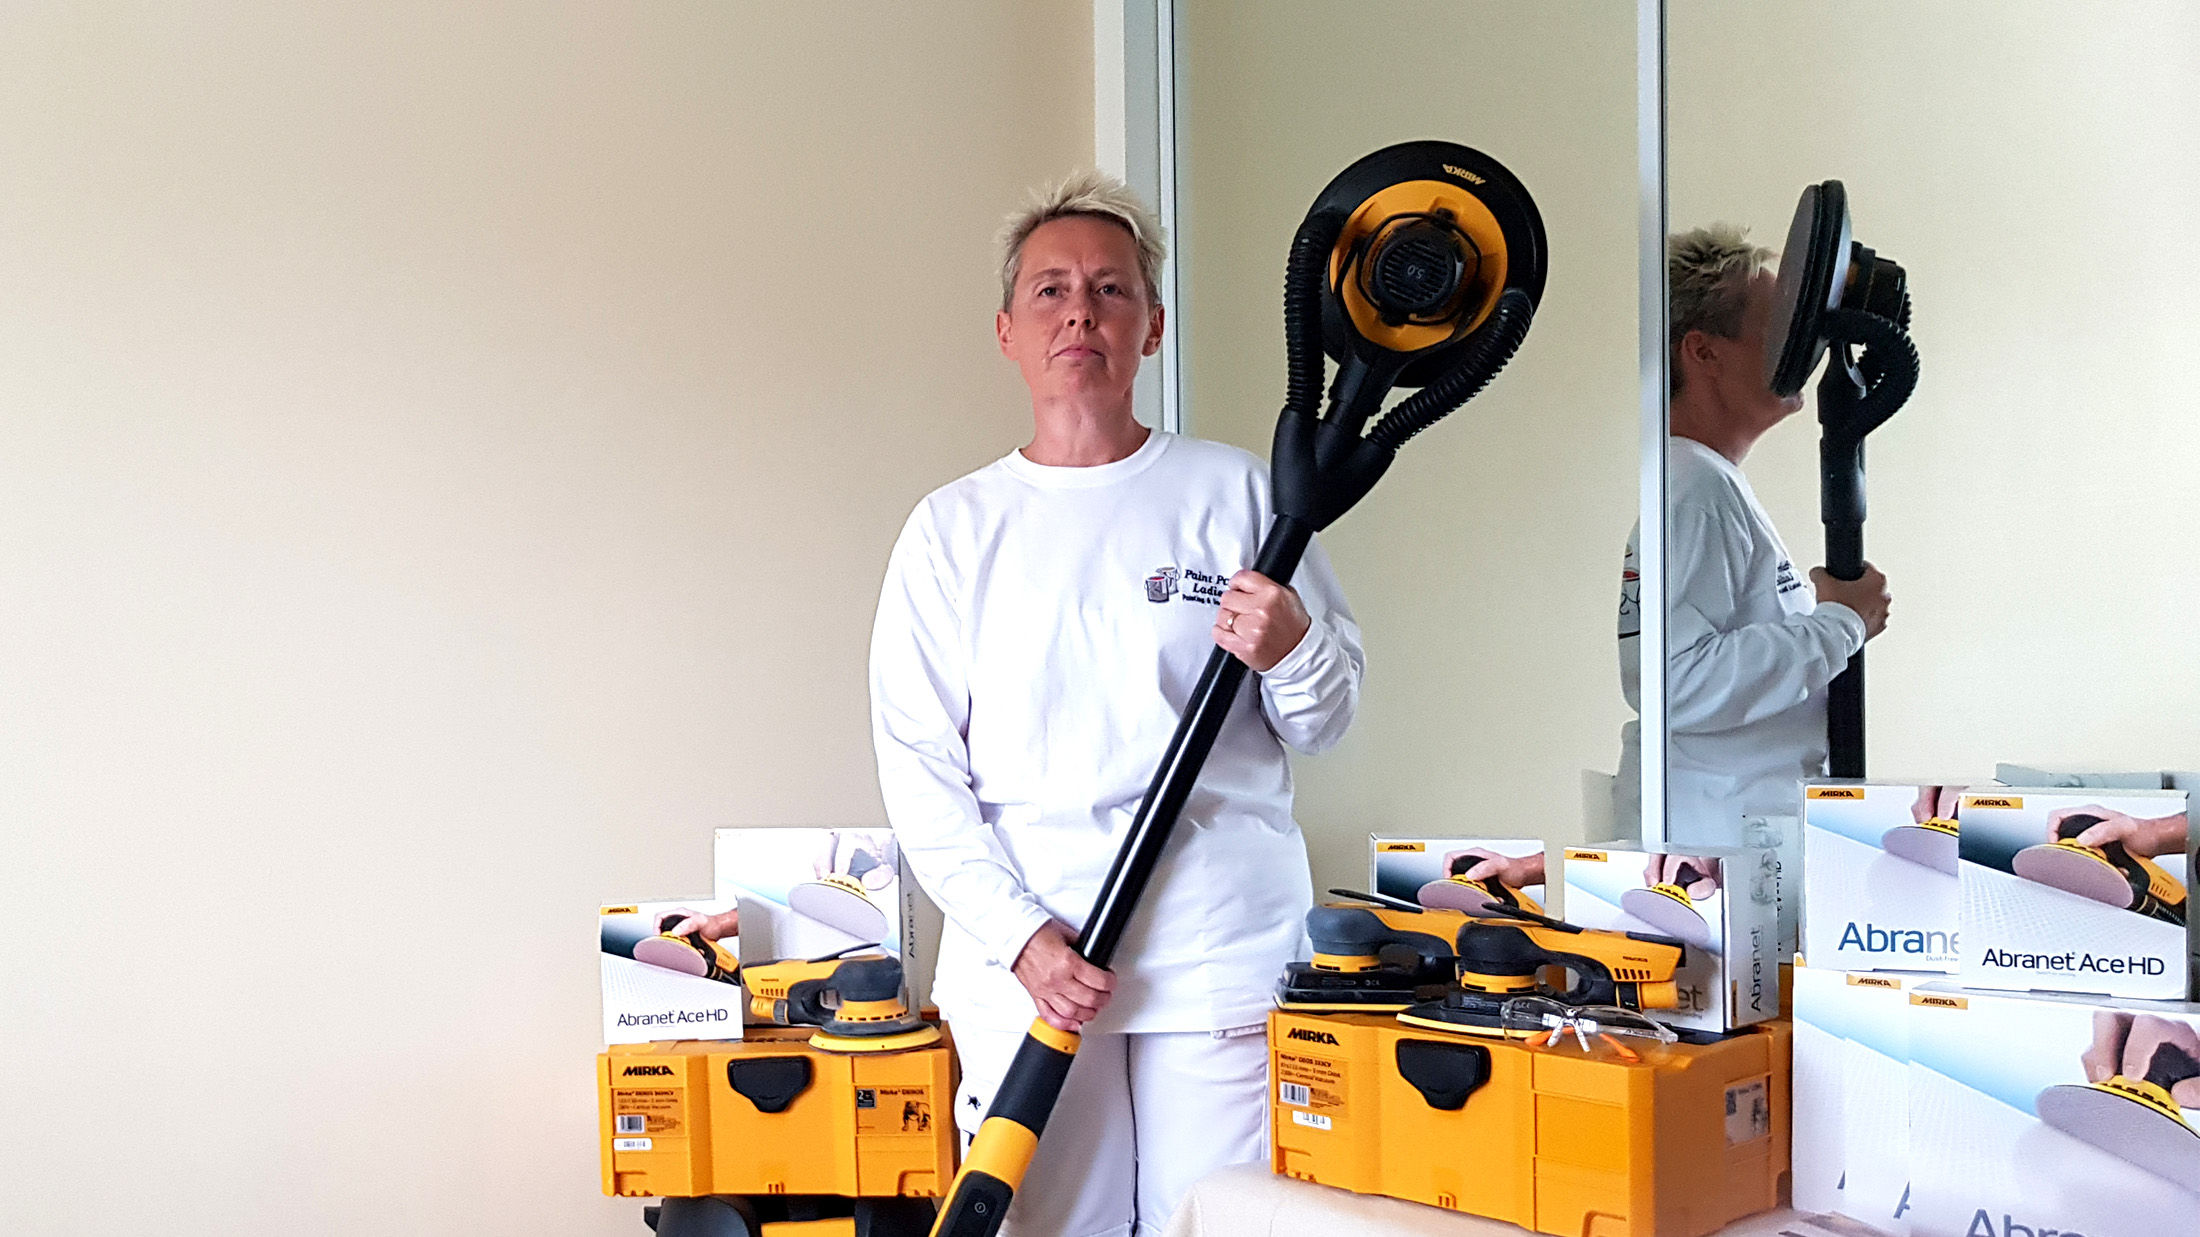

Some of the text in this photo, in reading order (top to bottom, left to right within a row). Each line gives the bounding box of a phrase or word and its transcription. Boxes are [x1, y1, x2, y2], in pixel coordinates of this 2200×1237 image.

[1443, 163, 1486, 185] MIRKA
[1185, 569, 1212, 583] Paint
[1192, 583, 1223, 597] Ladie
[1819, 790, 1854, 798] MIRKA
[1973, 799, 2011, 807] MIRKA
[1573, 852, 1600, 860] MIRKA
[1838, 922, 1959, 954] Abrane
[1750, 926, 1761, 1012] Abranet
[2078, 953, 2125, 973] Ace
[2128, 956, 2165, 976] HD
[1857, 978, 1892, 987] MIRKA
[1921, 997, 1957, 1007] MIRKA
[677, 1010, 704, 1024] Ace
[706, 1008, 728, 1022] HD
[1287, 1027, 1340, 1046] MIRKA
[622, 1065, 674, 1076] MIRKA
